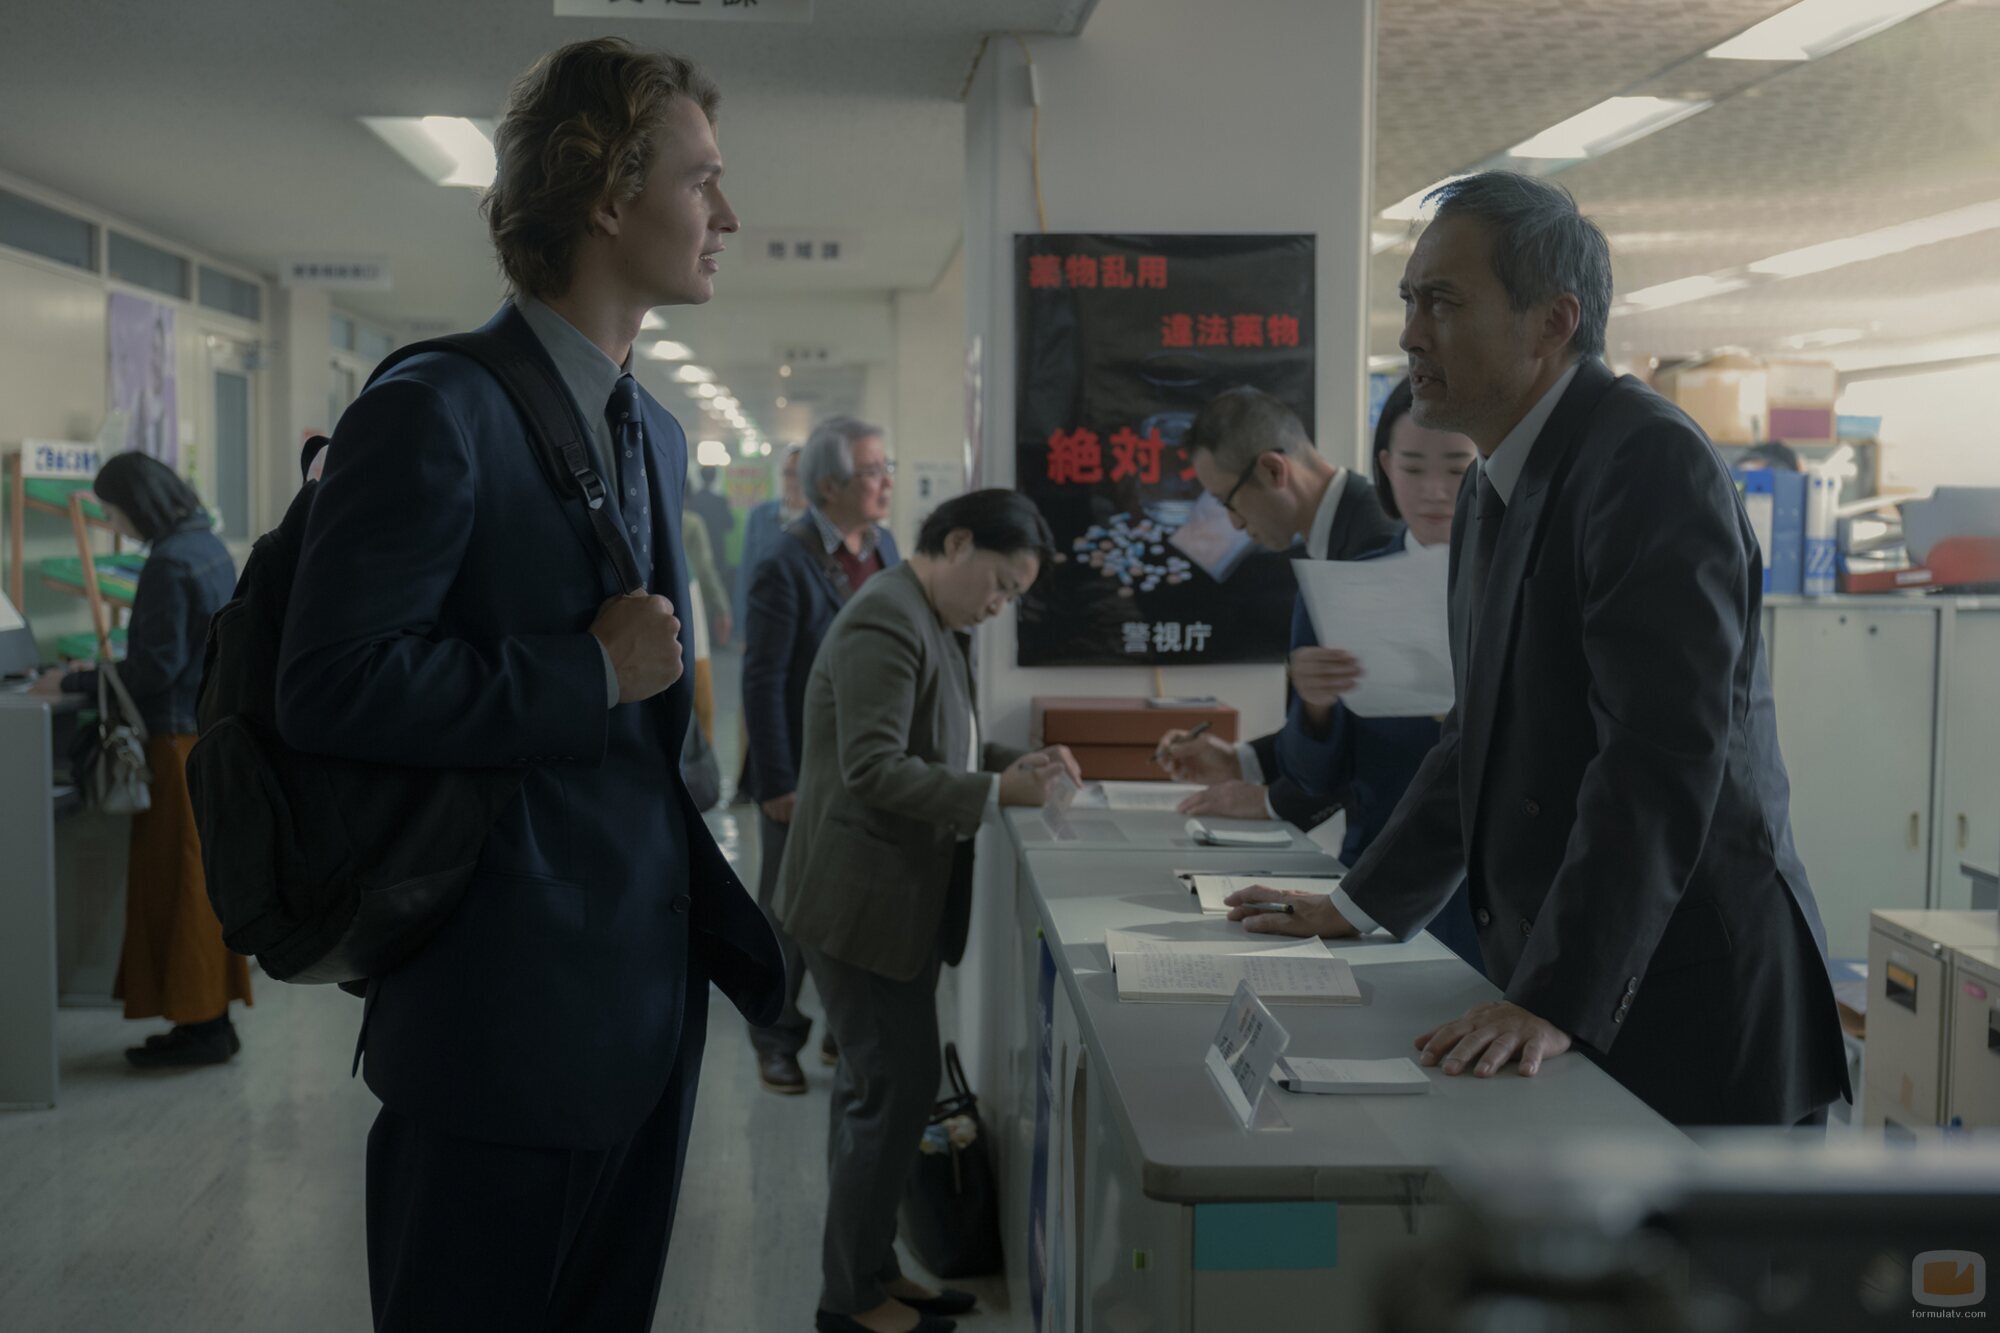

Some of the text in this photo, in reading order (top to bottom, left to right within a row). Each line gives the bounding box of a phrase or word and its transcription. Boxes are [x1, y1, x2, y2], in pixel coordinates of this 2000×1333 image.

[1161, 312, 1299, 347] 違法薬物
[1121, 620, 1213, 652] 警視庁
